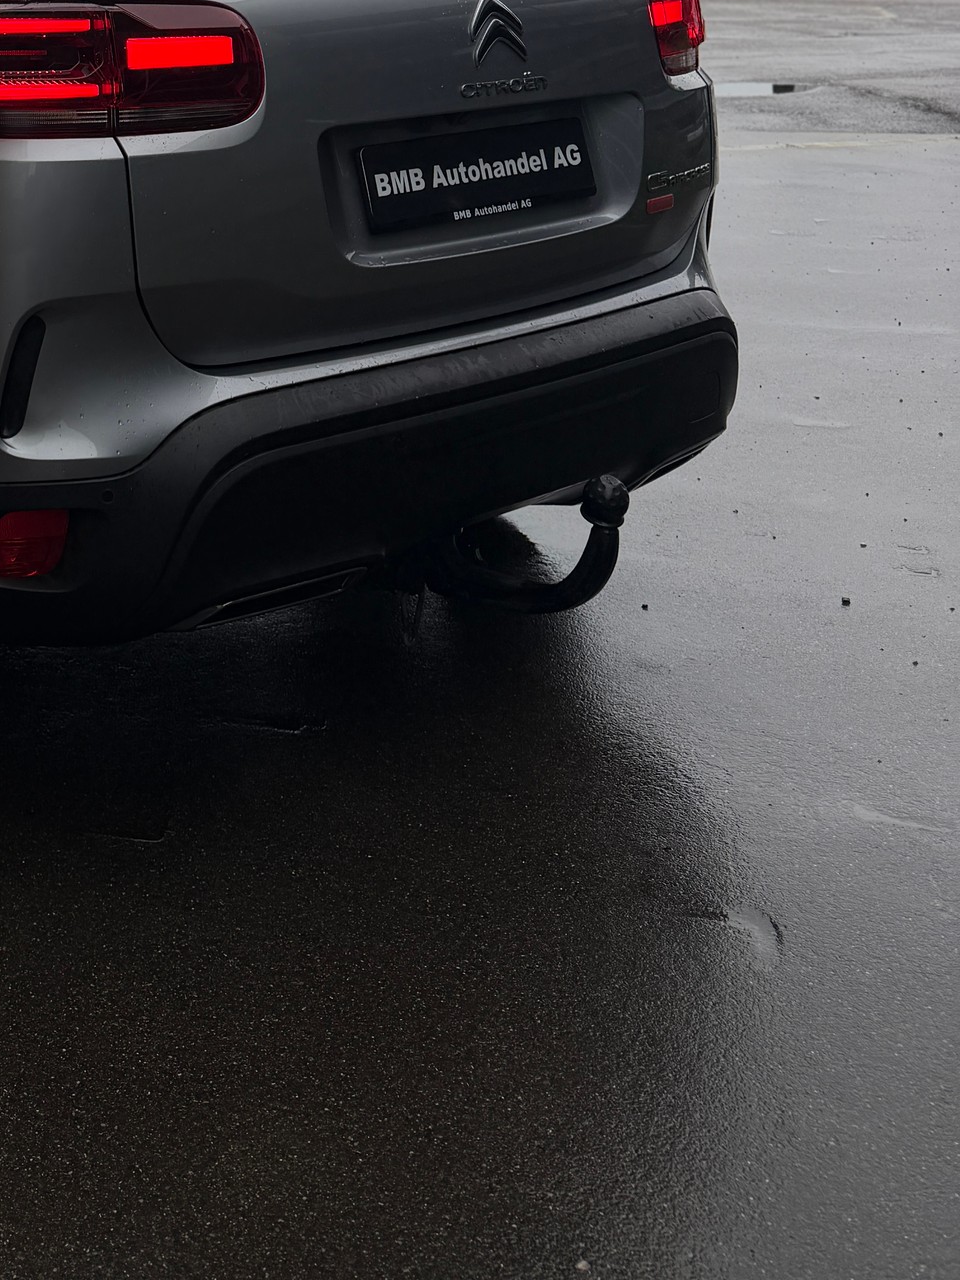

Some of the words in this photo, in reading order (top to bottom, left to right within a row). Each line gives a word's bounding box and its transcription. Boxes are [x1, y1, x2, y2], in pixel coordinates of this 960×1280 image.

[374, 168, 426, 197] BMB
[432, 149, 548, 188] Autohandel
[553, 143, 582, 168] AG
[453, 209, 472, 220] BMB
[474, 200, 519, 217] Autohandel
[521, 198, 532, 208] AG
